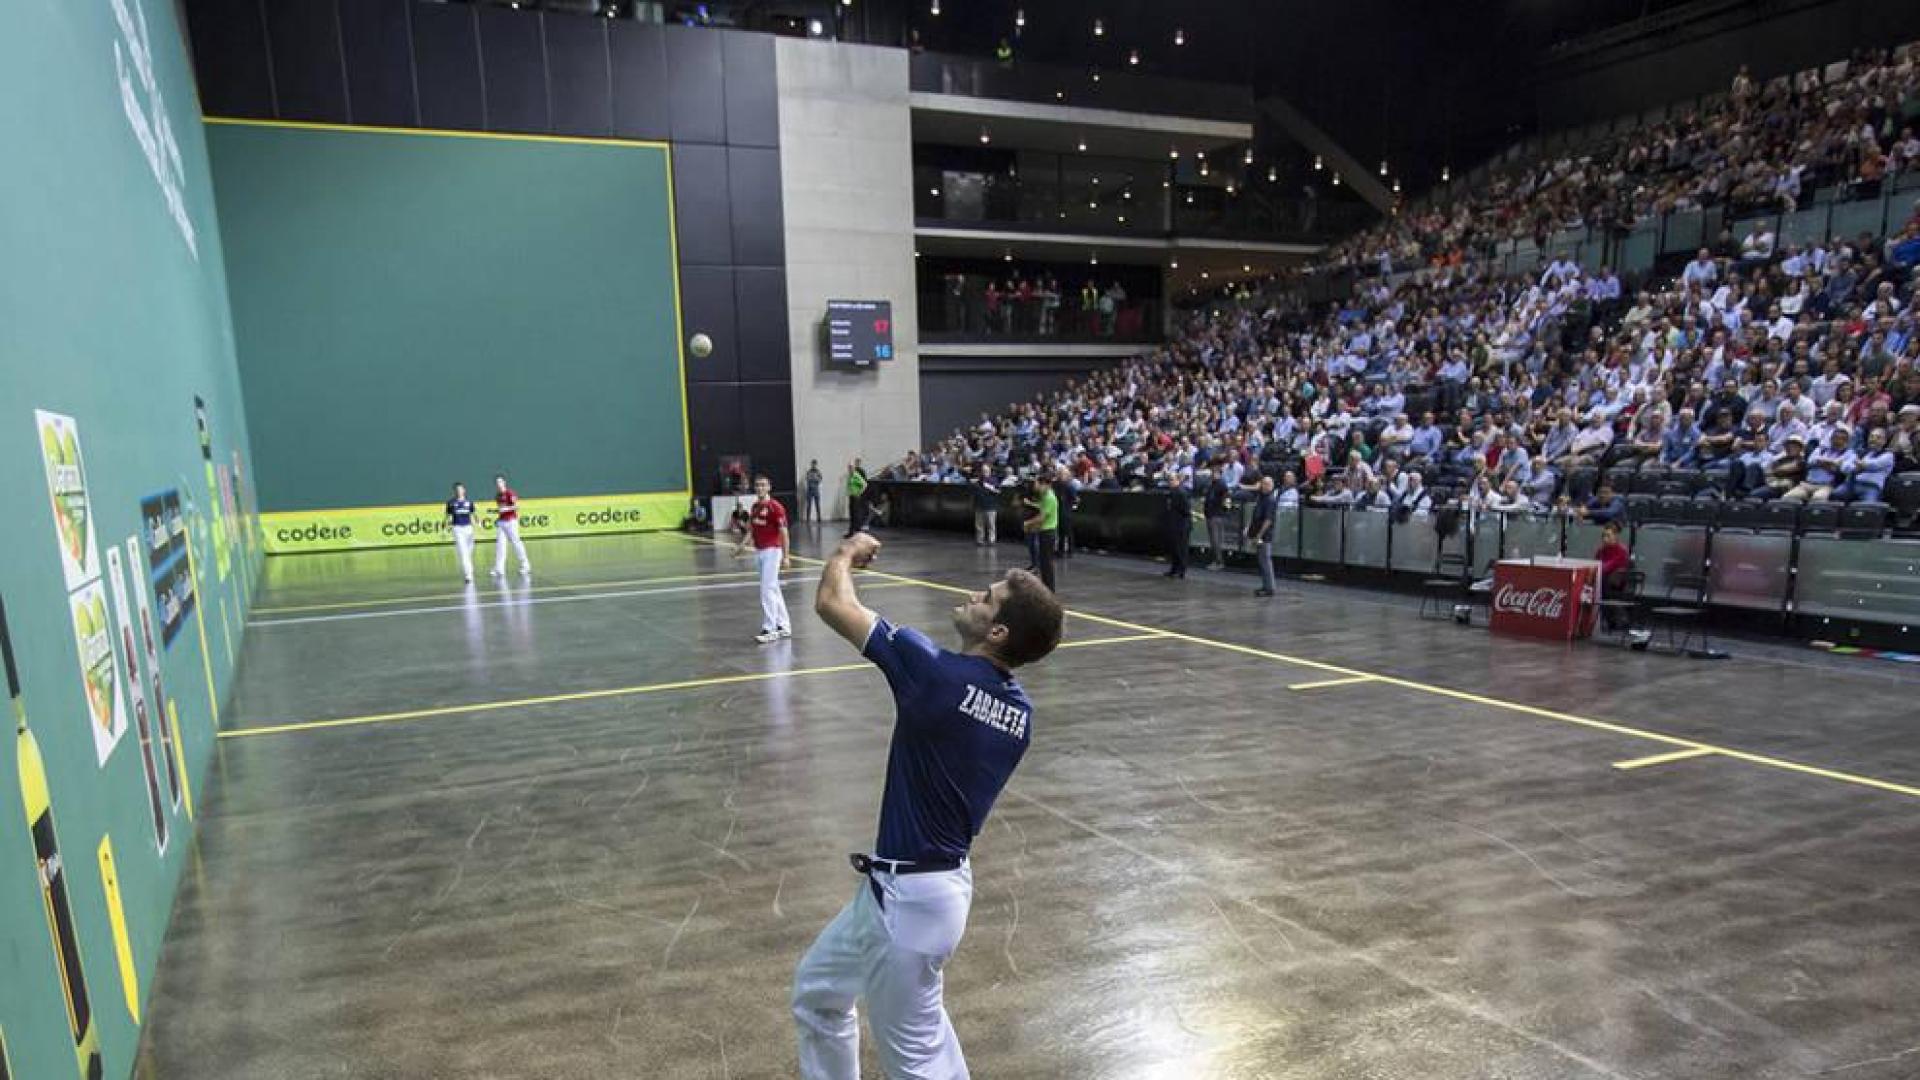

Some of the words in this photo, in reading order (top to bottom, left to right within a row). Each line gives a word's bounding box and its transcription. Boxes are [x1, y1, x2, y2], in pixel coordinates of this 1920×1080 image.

[575, 508, 641, 525] codere
[277, 523, 351, 542] codere
[959, 684, 1027, 739] ZABALETA
